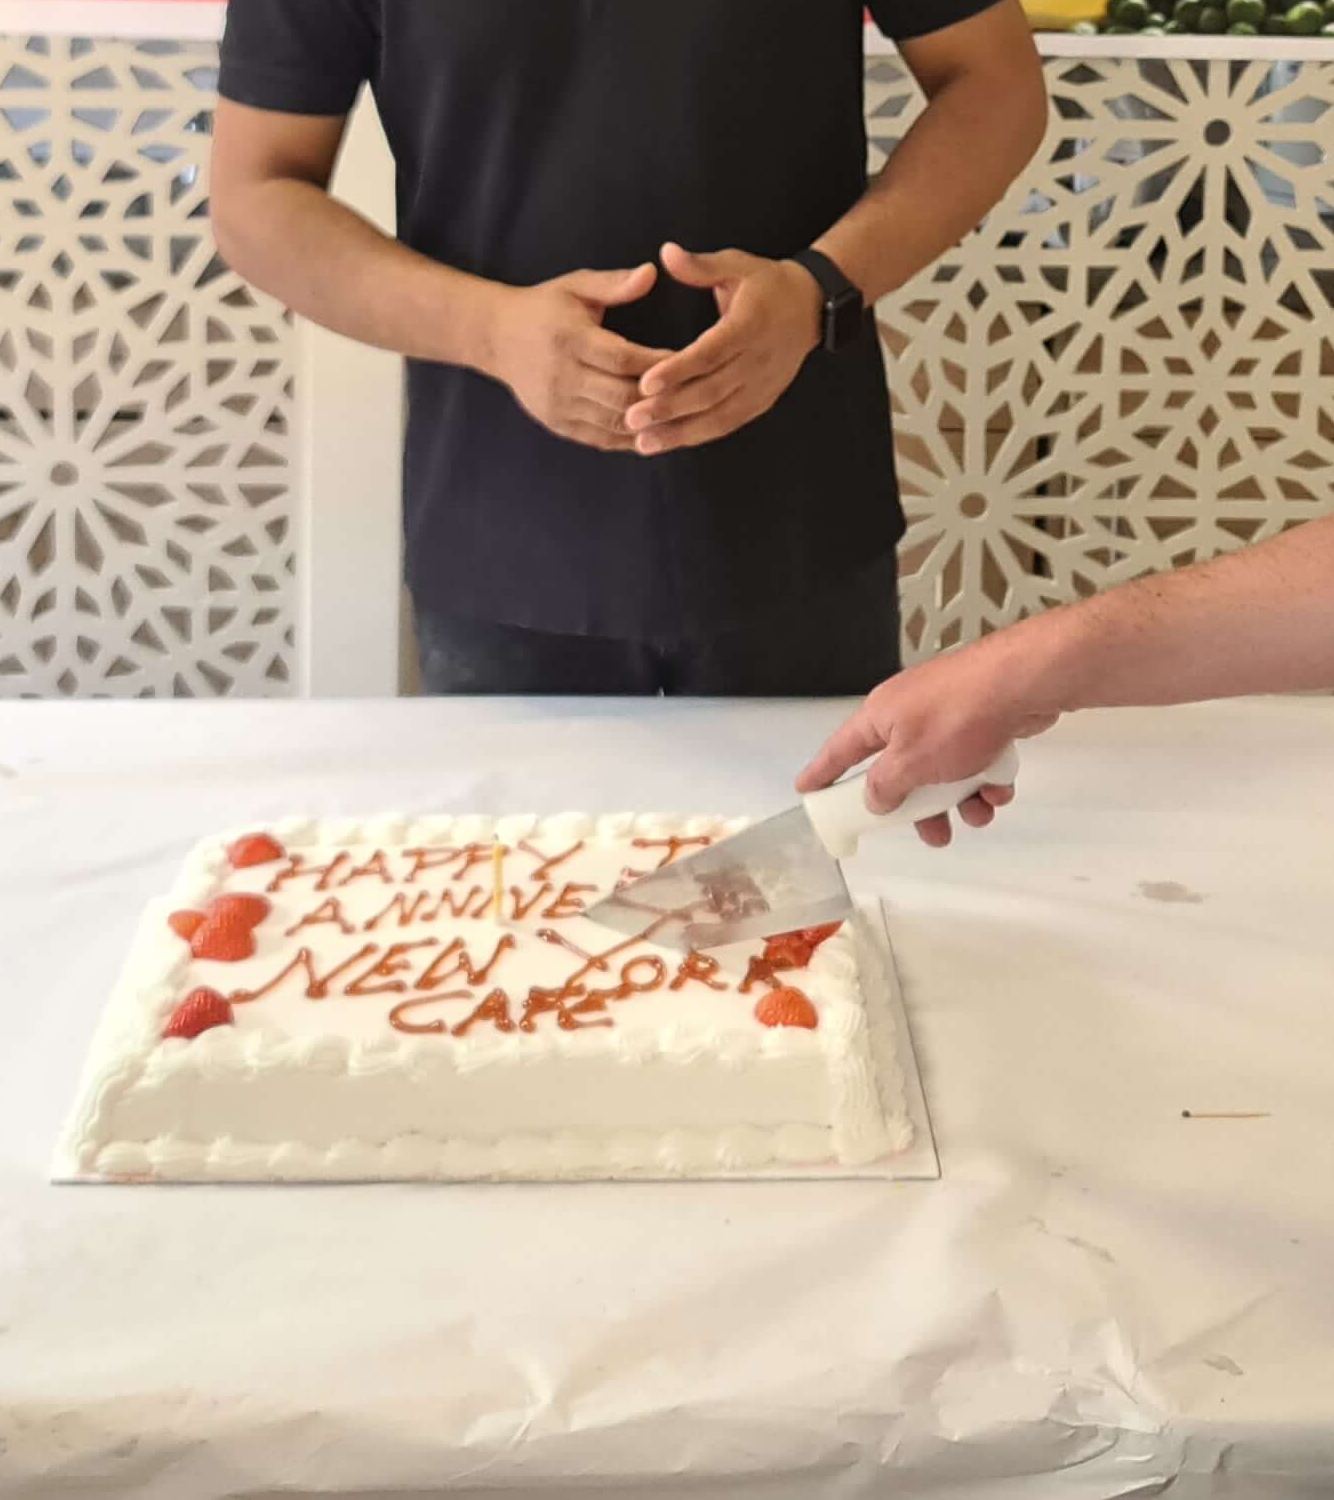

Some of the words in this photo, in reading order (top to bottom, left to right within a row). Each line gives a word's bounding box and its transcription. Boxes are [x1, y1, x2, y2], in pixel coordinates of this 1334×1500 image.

[266, 838, 585, 893] HAPPY
[227, 933, 517, 1005] NEW
[388, 986, 617, 1038] CAFE
